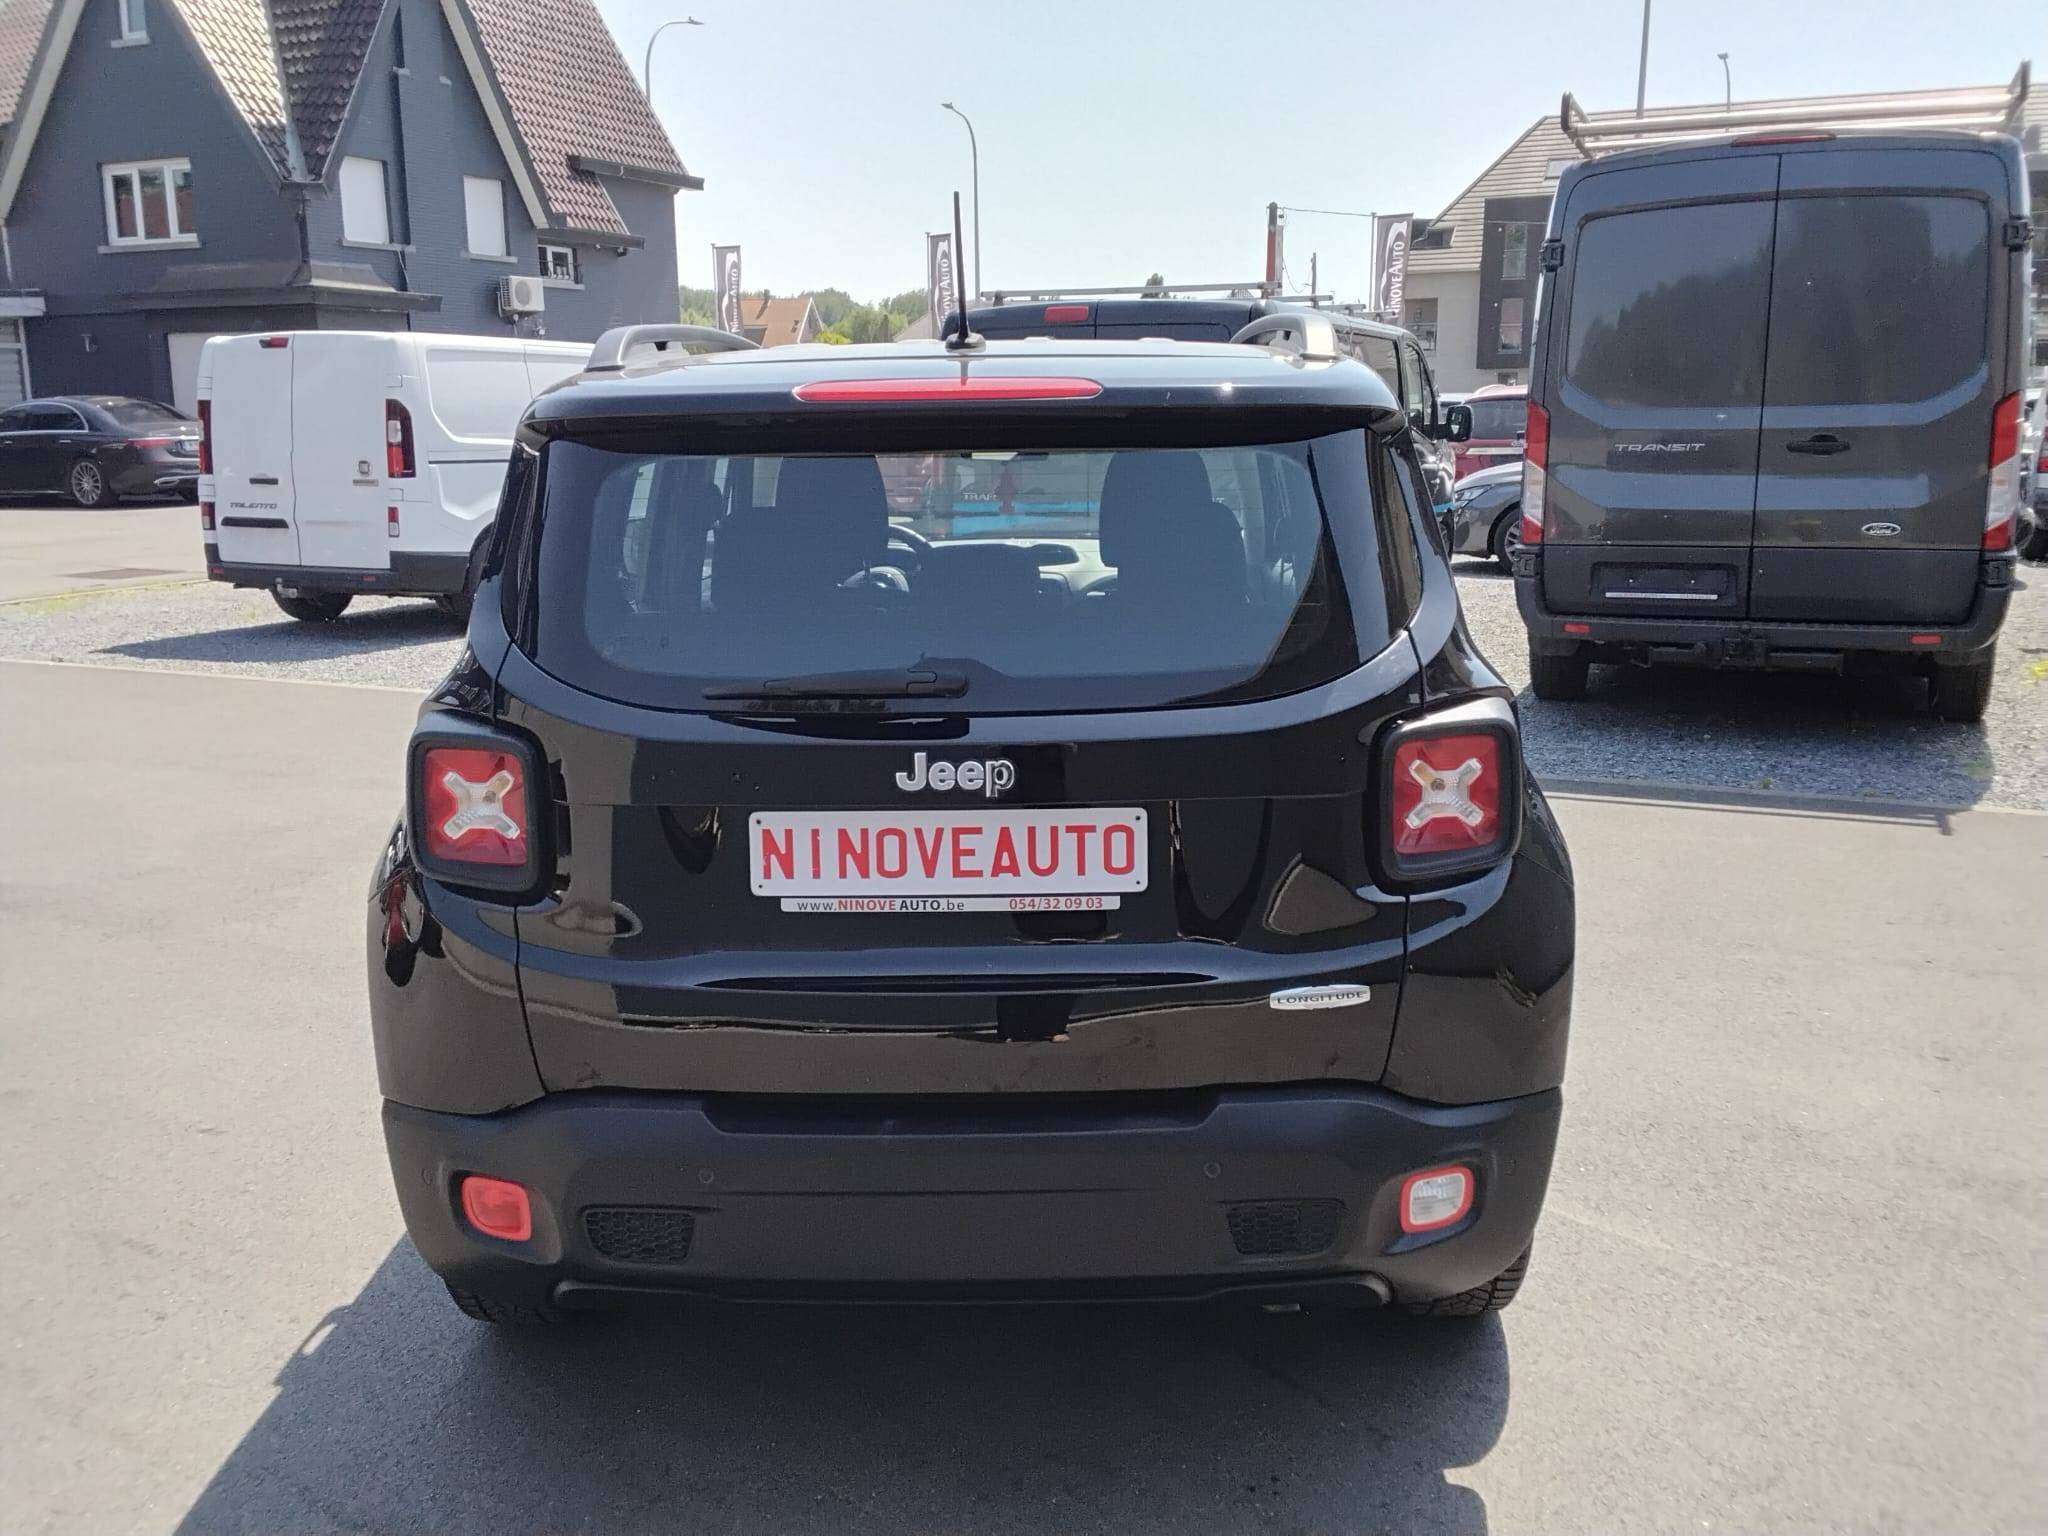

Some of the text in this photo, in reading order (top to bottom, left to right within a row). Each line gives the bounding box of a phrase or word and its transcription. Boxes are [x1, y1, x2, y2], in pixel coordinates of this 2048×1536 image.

[1614, 443, 1705, 452] TRANSIT
[229, 502, 278, 510] TALENTO
[895, 752, 1015, 798] Jeep
[761, 824, 1136, 880] NINOVEAUTO
[1009, 897, 1103, 911] 054/32 09 03
[1276, 991, 1364, 1005] LONGITUDE
